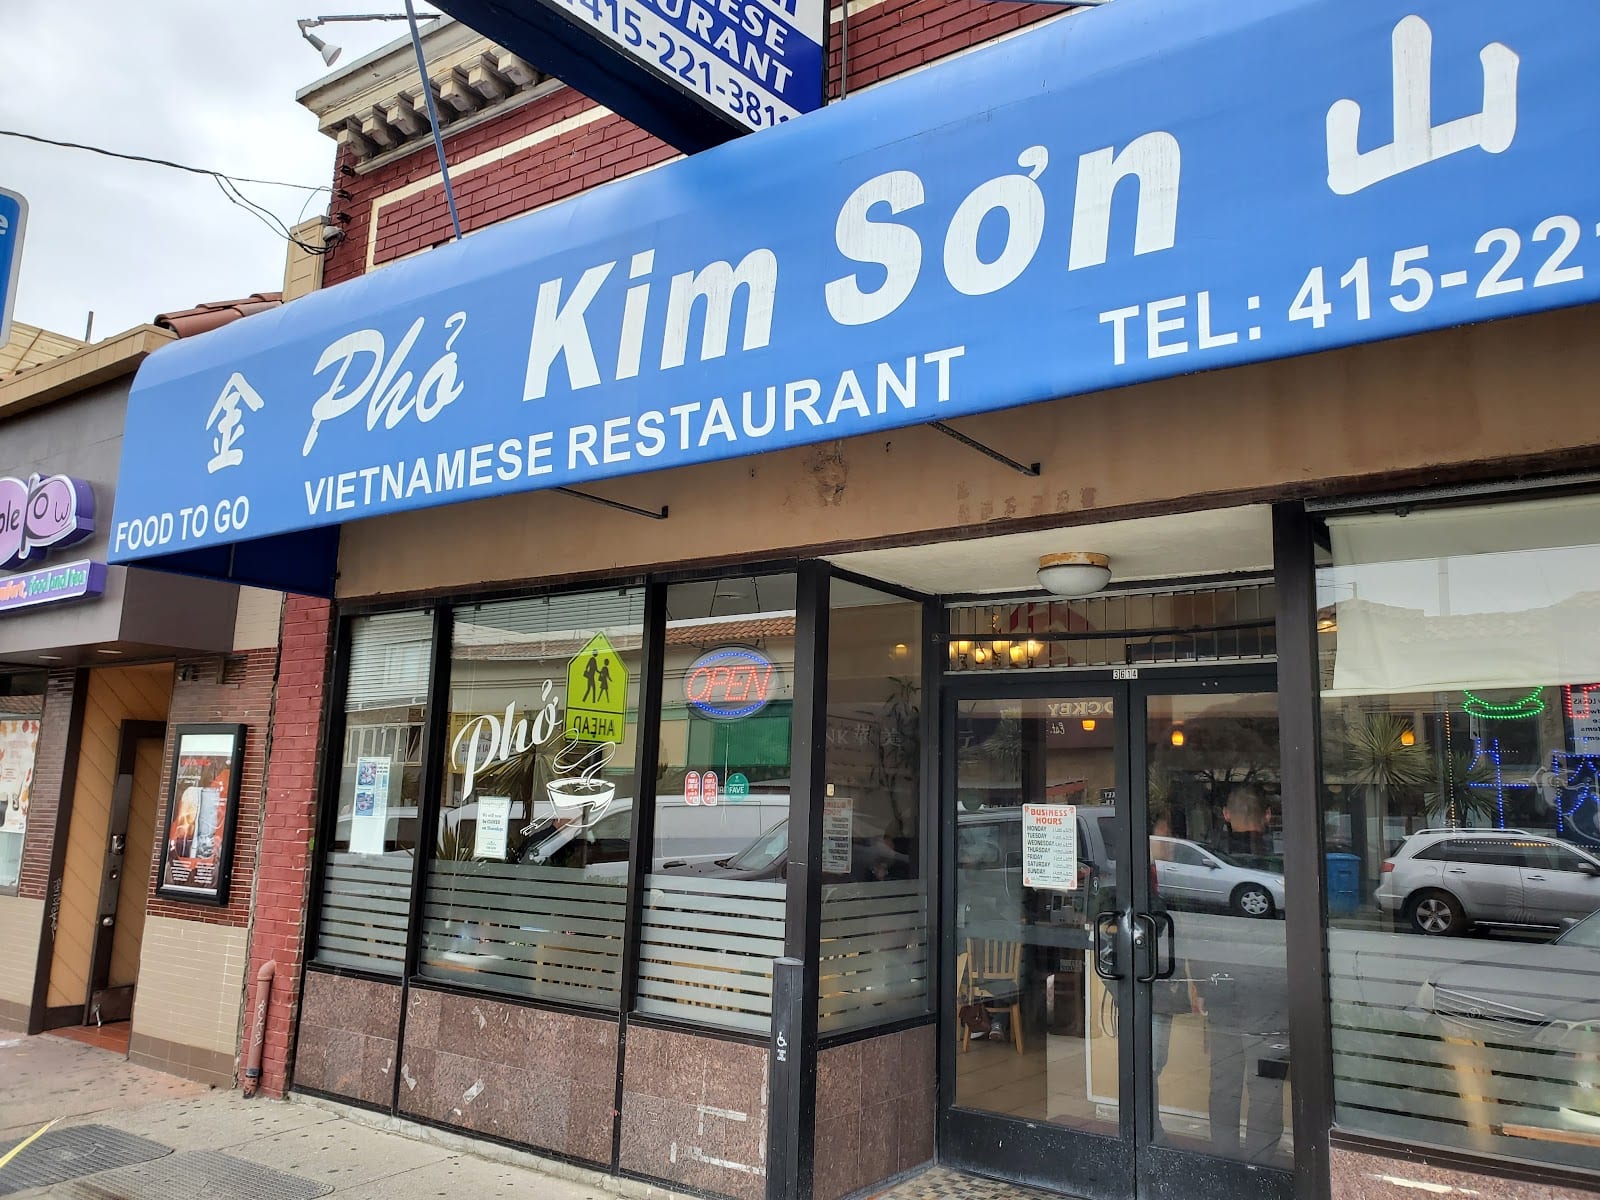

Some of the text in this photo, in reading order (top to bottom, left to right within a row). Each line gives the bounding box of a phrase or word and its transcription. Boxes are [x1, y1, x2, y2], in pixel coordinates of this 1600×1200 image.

[579, 0, 789, 126] 415-221-381
[1326, 14, 1520, 195] 山
[523, 248, 778, 401] Kim
[825, 131, 1181, 326] Sơn
[1100, 215, 1600, 366] TEL: 415-22
[206, 372, 265, 474] 金
[304, 345, 965, 516] VIETNAMESE RESTAURANT
[115, 495, 249, 553] FOOD TO GO
[687, 664, 772, 702] OPEN
[1113, 669, 1138, 680] 3614
[729, 786, 744, 794] FAVE
[1030, 808, 1068, 817] BUSINESS
[1036, 817, 1063, 825] HOURS
